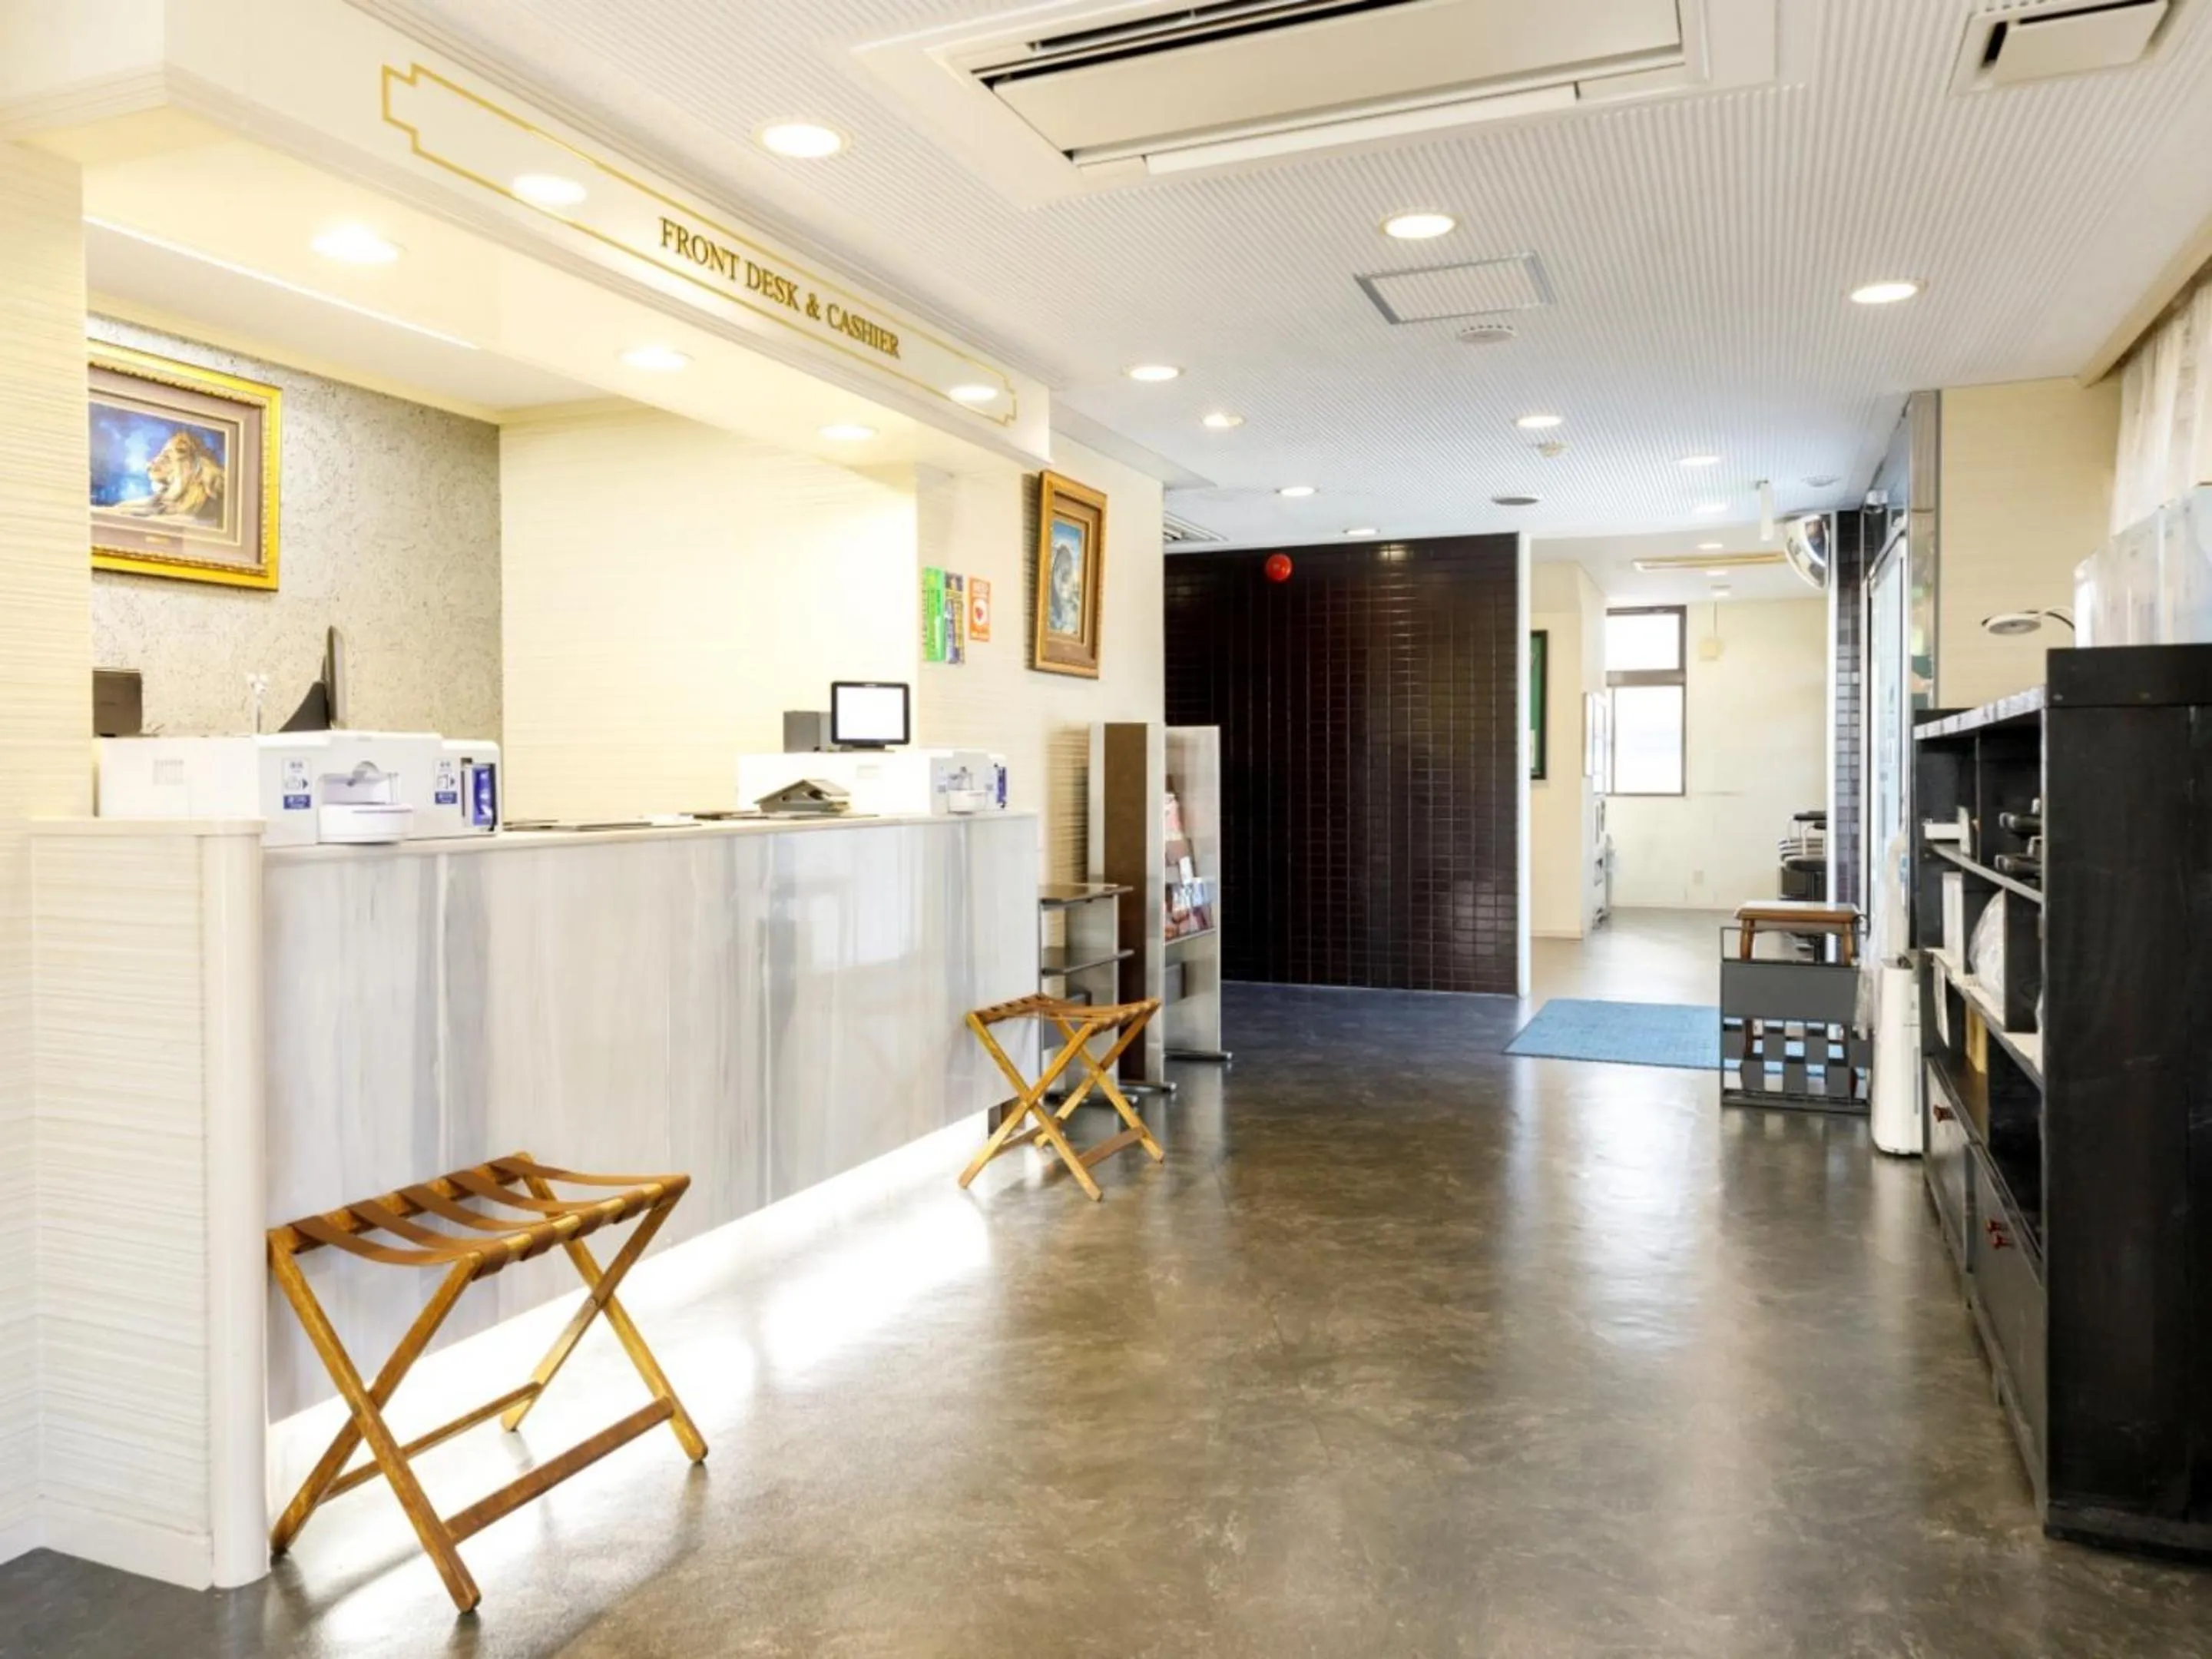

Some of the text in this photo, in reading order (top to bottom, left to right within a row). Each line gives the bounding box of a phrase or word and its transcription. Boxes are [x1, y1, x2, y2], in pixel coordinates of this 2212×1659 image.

[660, 217, 900, 358] FRONT DESK & CASHIER
